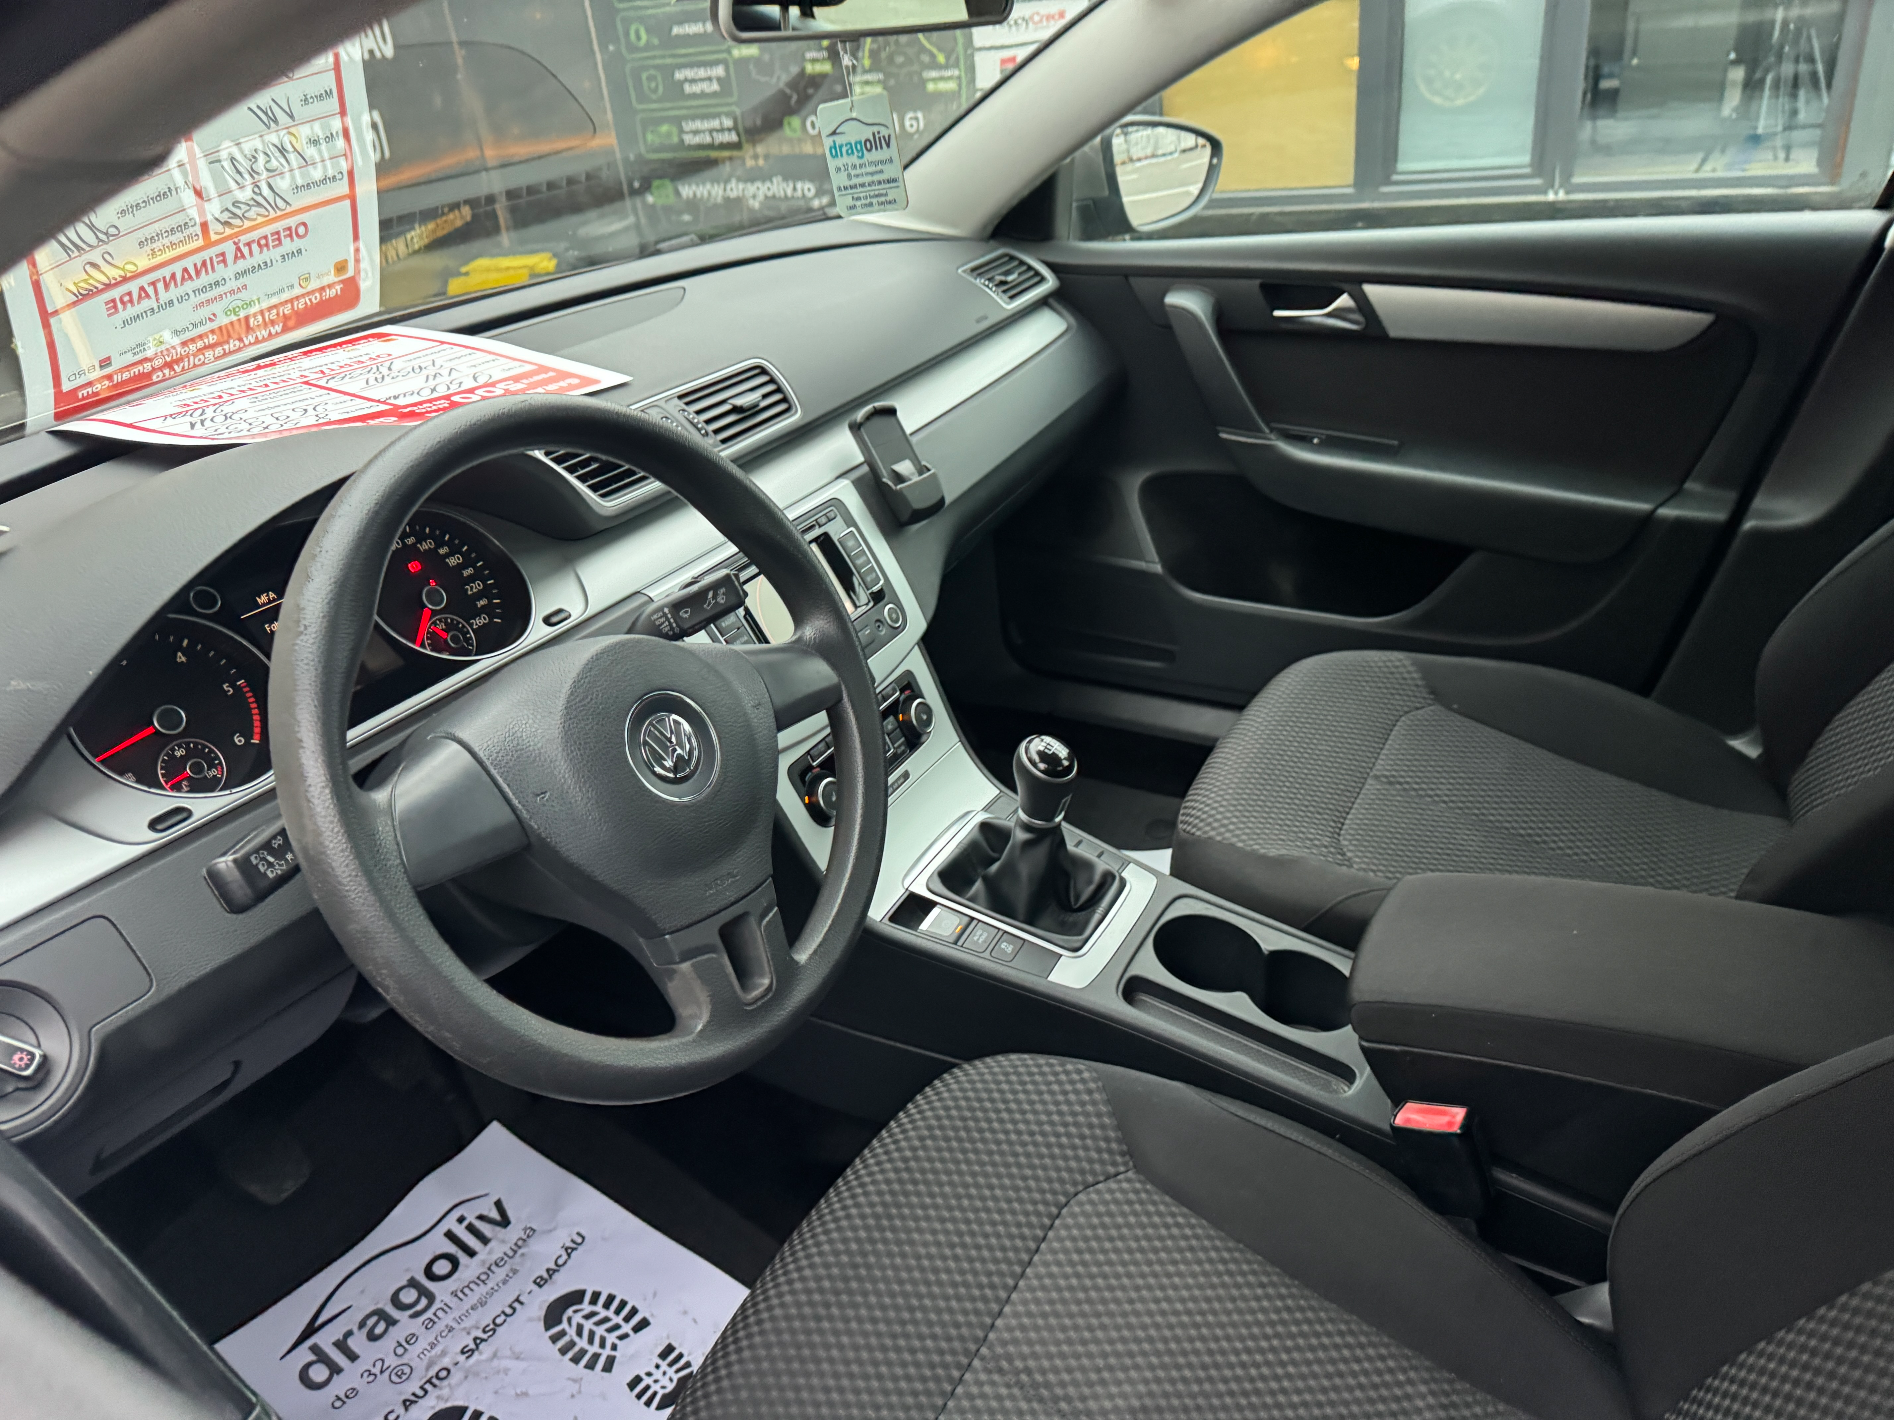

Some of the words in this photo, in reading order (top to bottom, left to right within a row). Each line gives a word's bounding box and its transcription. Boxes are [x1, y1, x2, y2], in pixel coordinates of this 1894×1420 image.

[904, 111, 924, 133] 61
[829, 130, 891, 159] dragoliv
[677, 173, 816, 204] www.dragoliv.ro
[404, 536, 416, 545] 120
[416, 539, 435, 553] 140
[437, 545, 450, 555] 160
[445, 554, 463, 567] 180
[461, 567, 474, 577] 200
[464, 580, 484, 595] 220
[255, 591, 277, 606] MFA
[476, 598, 488, 608] 240
[470, 614, 489, 629] 260
[175, 651, 187, 663] 4
[222, 683, 234, 696] 5
[233, 733, 245, 745] 6
[174, 748, 186, 758] 90
[299, 1197, 511, 1391] dragoliv
[331, 1386, 360, 1410] de
[360, 1358, 391, 1384] 32
[393, 1332, 419, 1357] de
[421, 1300, 453, 1331] ani
[450, 1224, 537, 1302] împreună
[416, 1324, 456, 1361] marcă
[452, 1266, 520, 1325] înregistrată
[401, 1367, 451, 1413] AUTO
[460, 1294, 525, 1360] SASCUT
[532, 1231, 586, 1289] BACĂU
